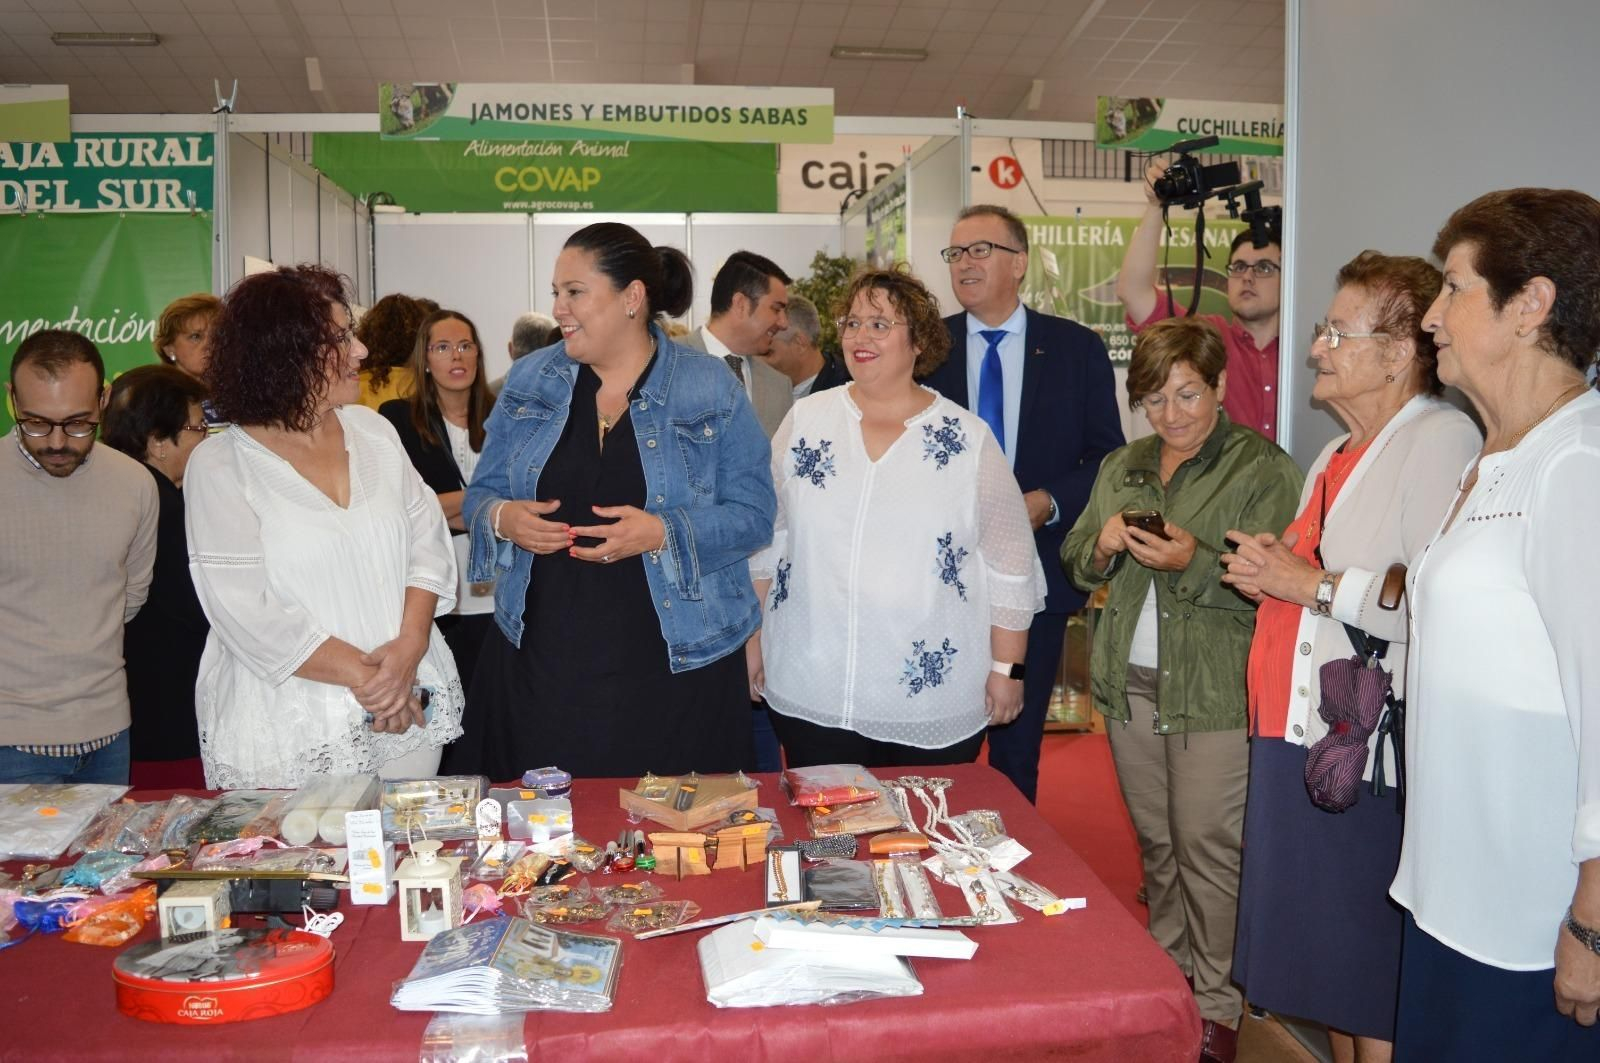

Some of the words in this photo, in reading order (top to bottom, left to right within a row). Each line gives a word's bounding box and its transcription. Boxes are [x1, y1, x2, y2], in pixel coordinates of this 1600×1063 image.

[470, 102, 573, 125] JAMONES
[581, 103, 595, 122] Y
[602, 103, 732, 124] EMBUTIDOS
[738, 106, 808, 126] SABAS
[73, 137, 214, 168] RURAL
[463, 139, 563, 157] Alimentación
[569, 140, 631, 158] Animal
[494, 166, 601, 193] COVAP
[0, 179, 80, 209] DEL
[97, 179, 187, 209] SUR
[503, 200, 594, 211] www.agrocovap.es
[1024, 220, 1124, 246] HILLERÍA
[177, 1009, 198, 1018] CAJA
[200, 1008, 224, 1017] ROJA
